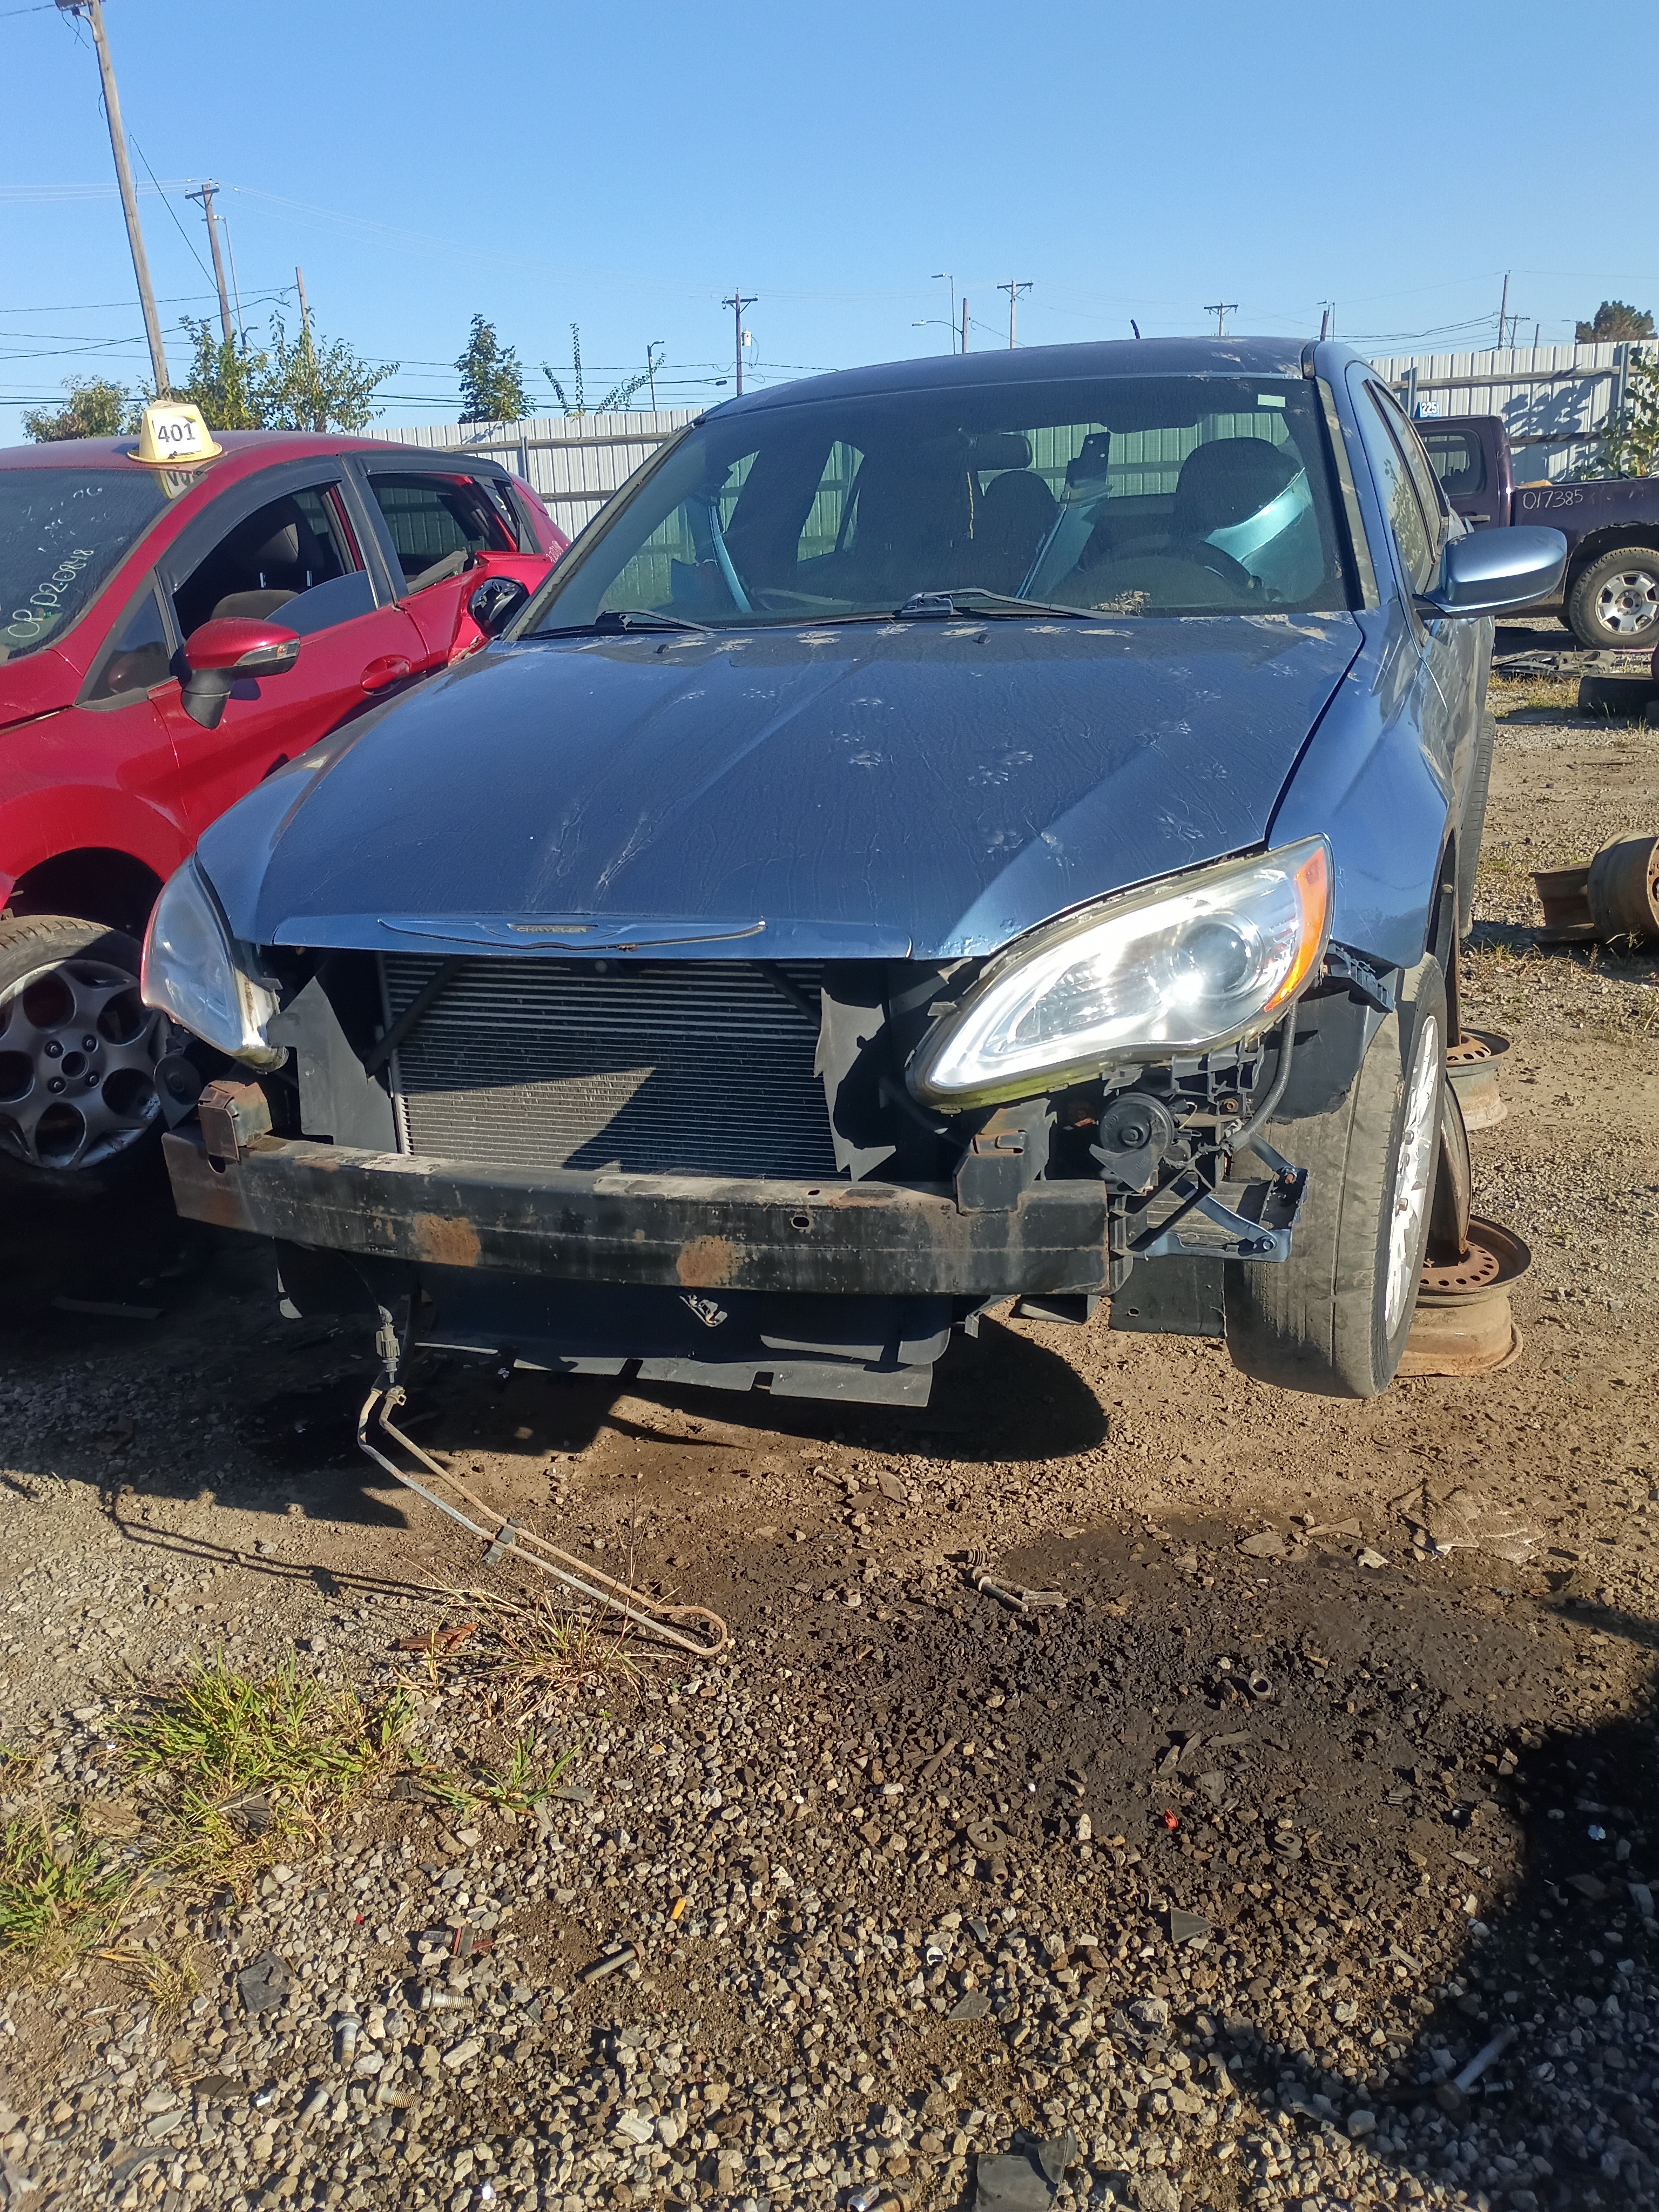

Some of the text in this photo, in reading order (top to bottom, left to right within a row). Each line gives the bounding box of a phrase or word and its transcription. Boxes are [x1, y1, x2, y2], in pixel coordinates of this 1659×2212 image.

[1421, 402, 1437, 414] 225
[158, 423, 196, 442] 401
[1522, 489, 1583, 509] 017385
